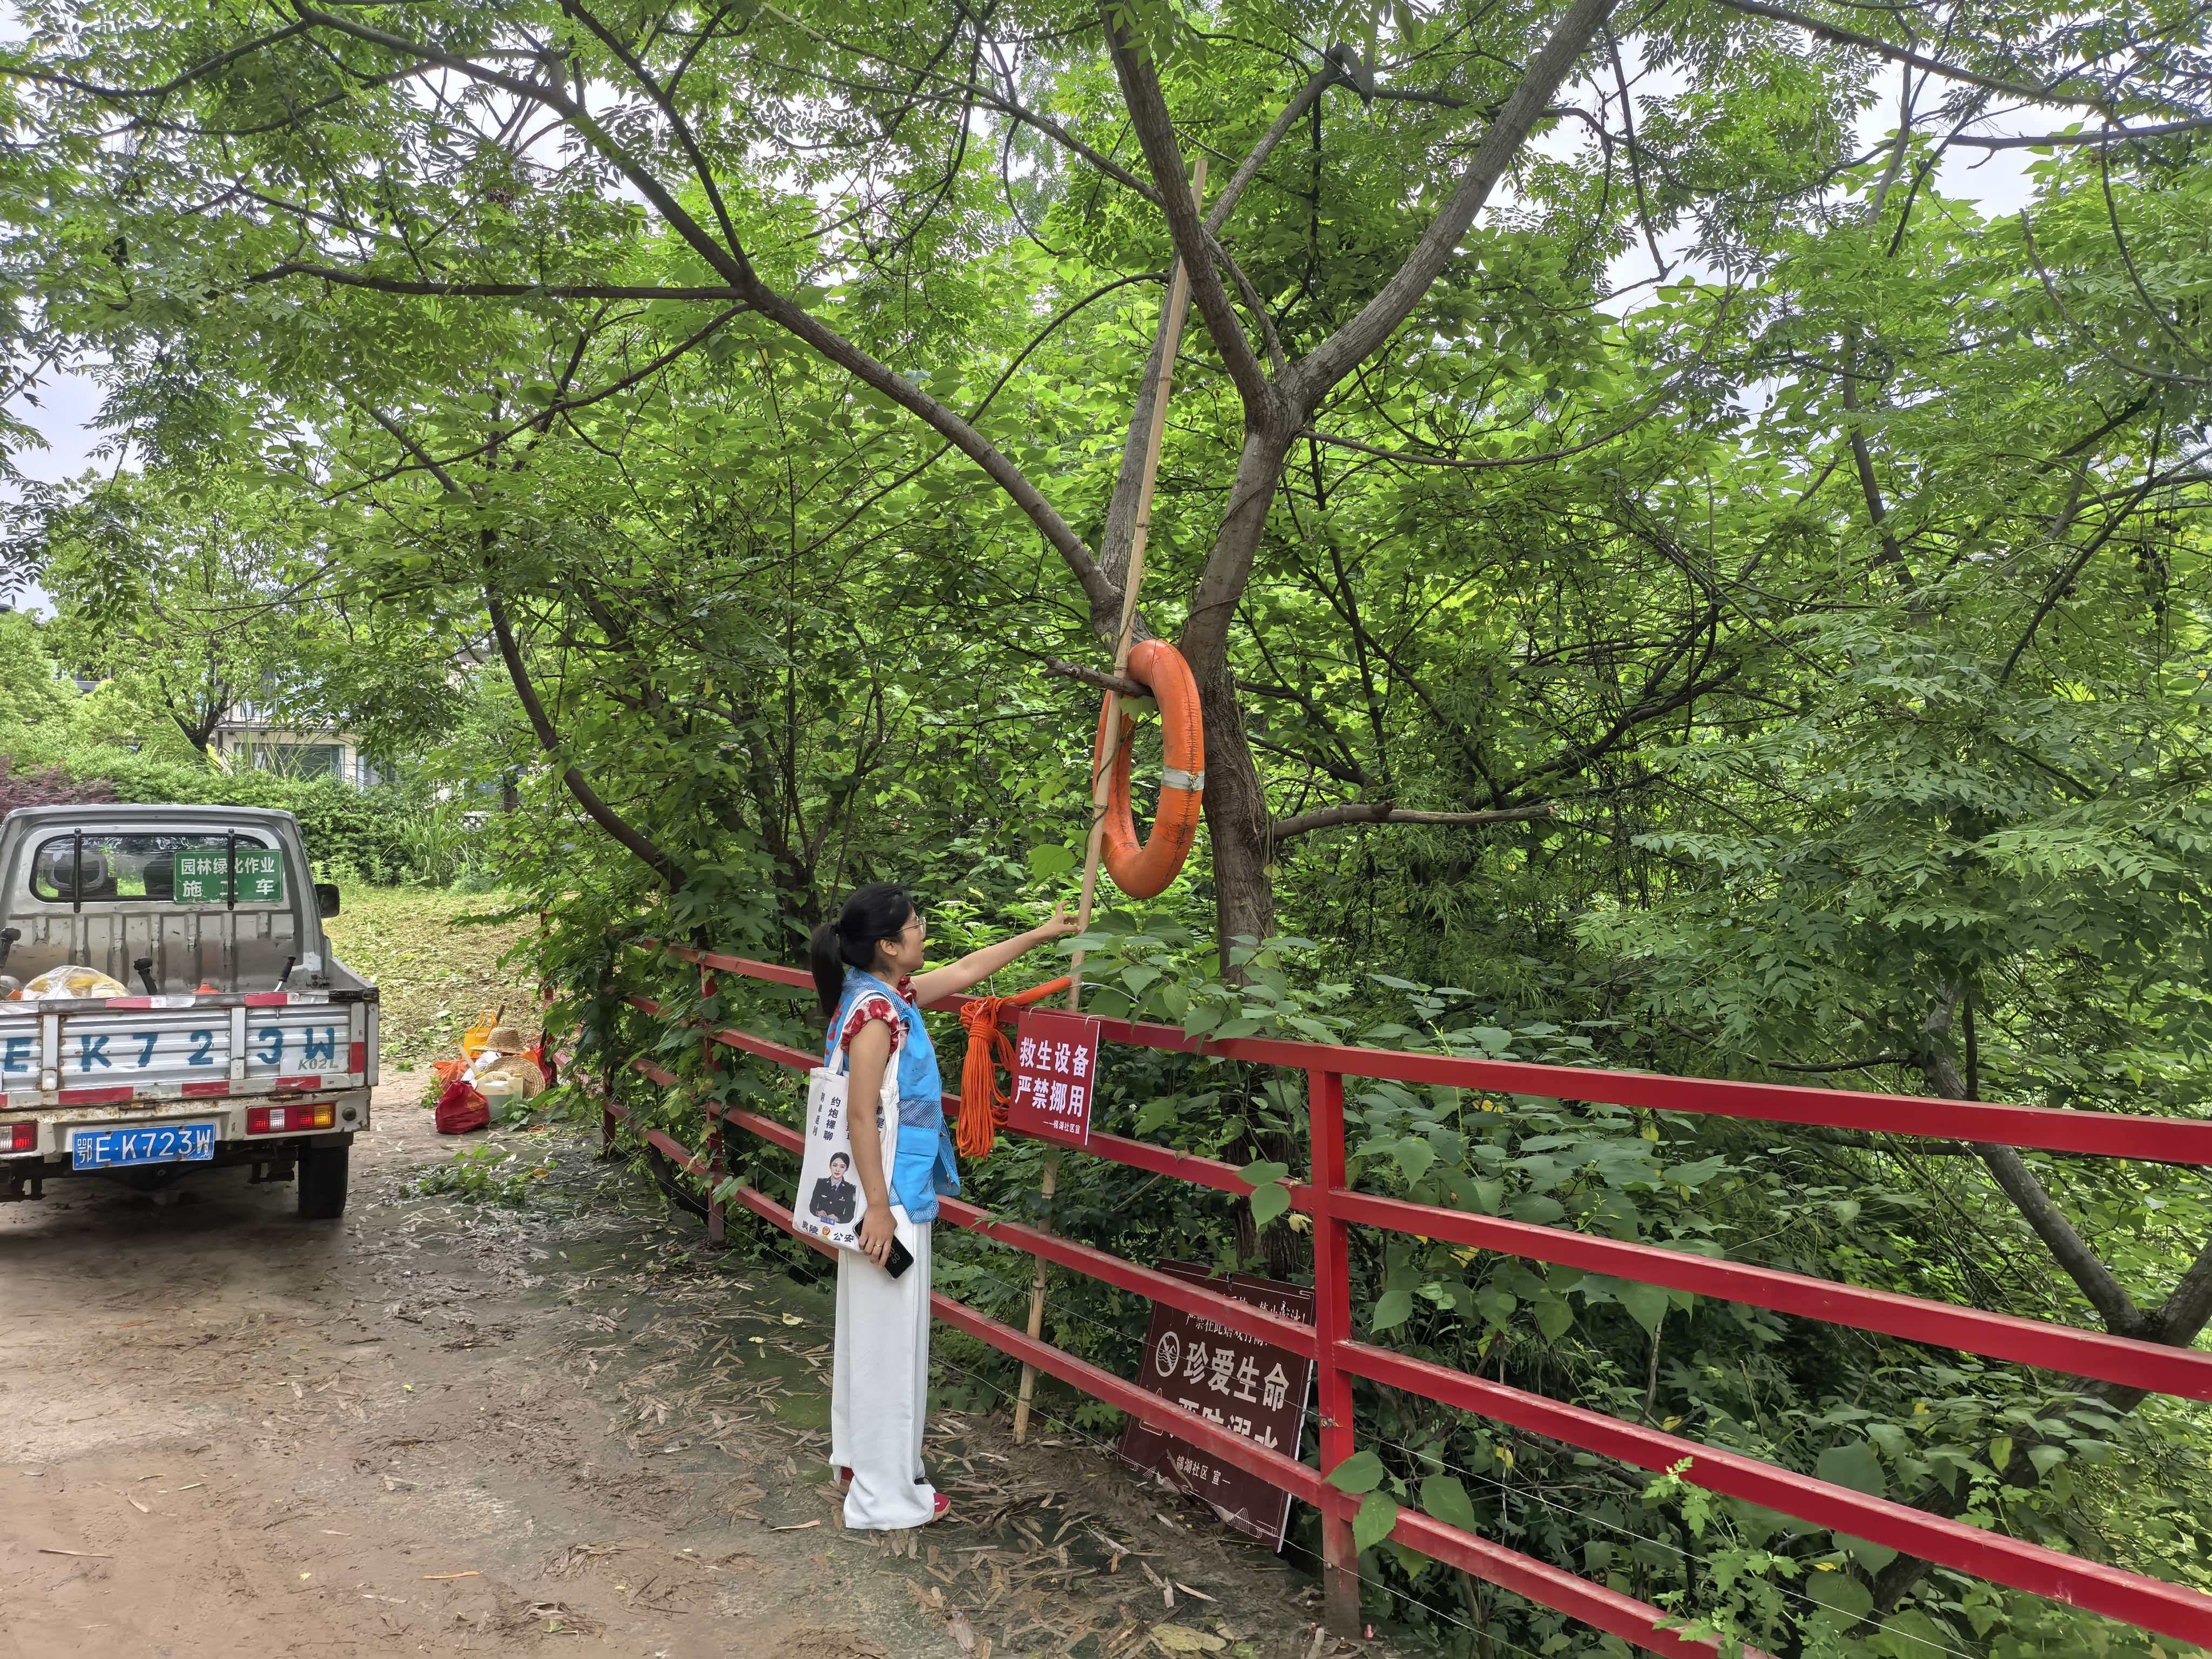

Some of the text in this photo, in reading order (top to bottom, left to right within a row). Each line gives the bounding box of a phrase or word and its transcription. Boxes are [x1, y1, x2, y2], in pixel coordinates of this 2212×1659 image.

[181, 857, 275, 875] 园林绿化作业
[298, 1058, 339, 1070] K02L
[1020, 1037, 1089, 1078] 救生设备
[1015, 1075, 1085, 1117] 严禁挪用
[823, 1096, 841, 1141] 约炮裸聊
[833, 1232, 854, 1243] 公安
[1183, 1341, 1290, 1412] 珍爱生命
